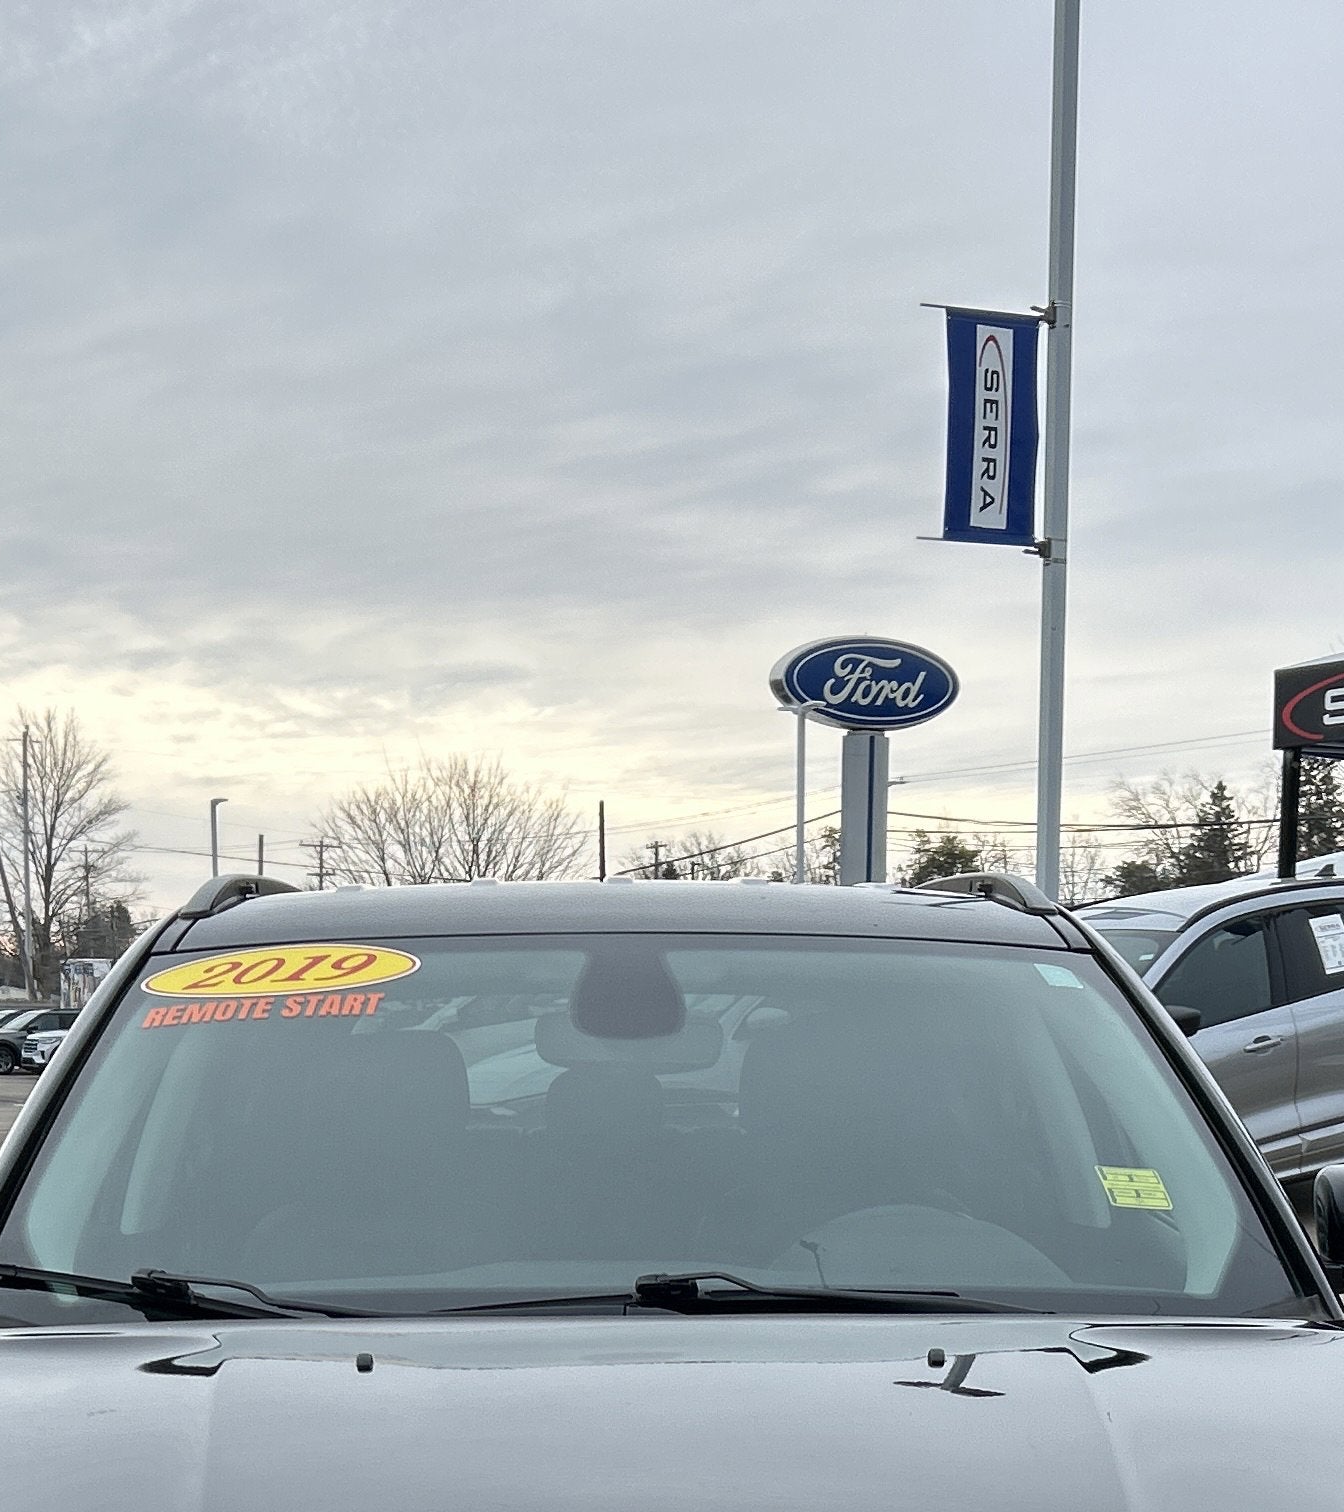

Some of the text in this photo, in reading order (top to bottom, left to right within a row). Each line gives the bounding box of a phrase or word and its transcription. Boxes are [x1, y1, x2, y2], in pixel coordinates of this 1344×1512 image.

[979, 368, 1000, 513] SERRA
[823, 654, 927, 708] Ford
[182, 953, 377, 990] 2019
[142, 993, 385, 1029] REMOTE START
